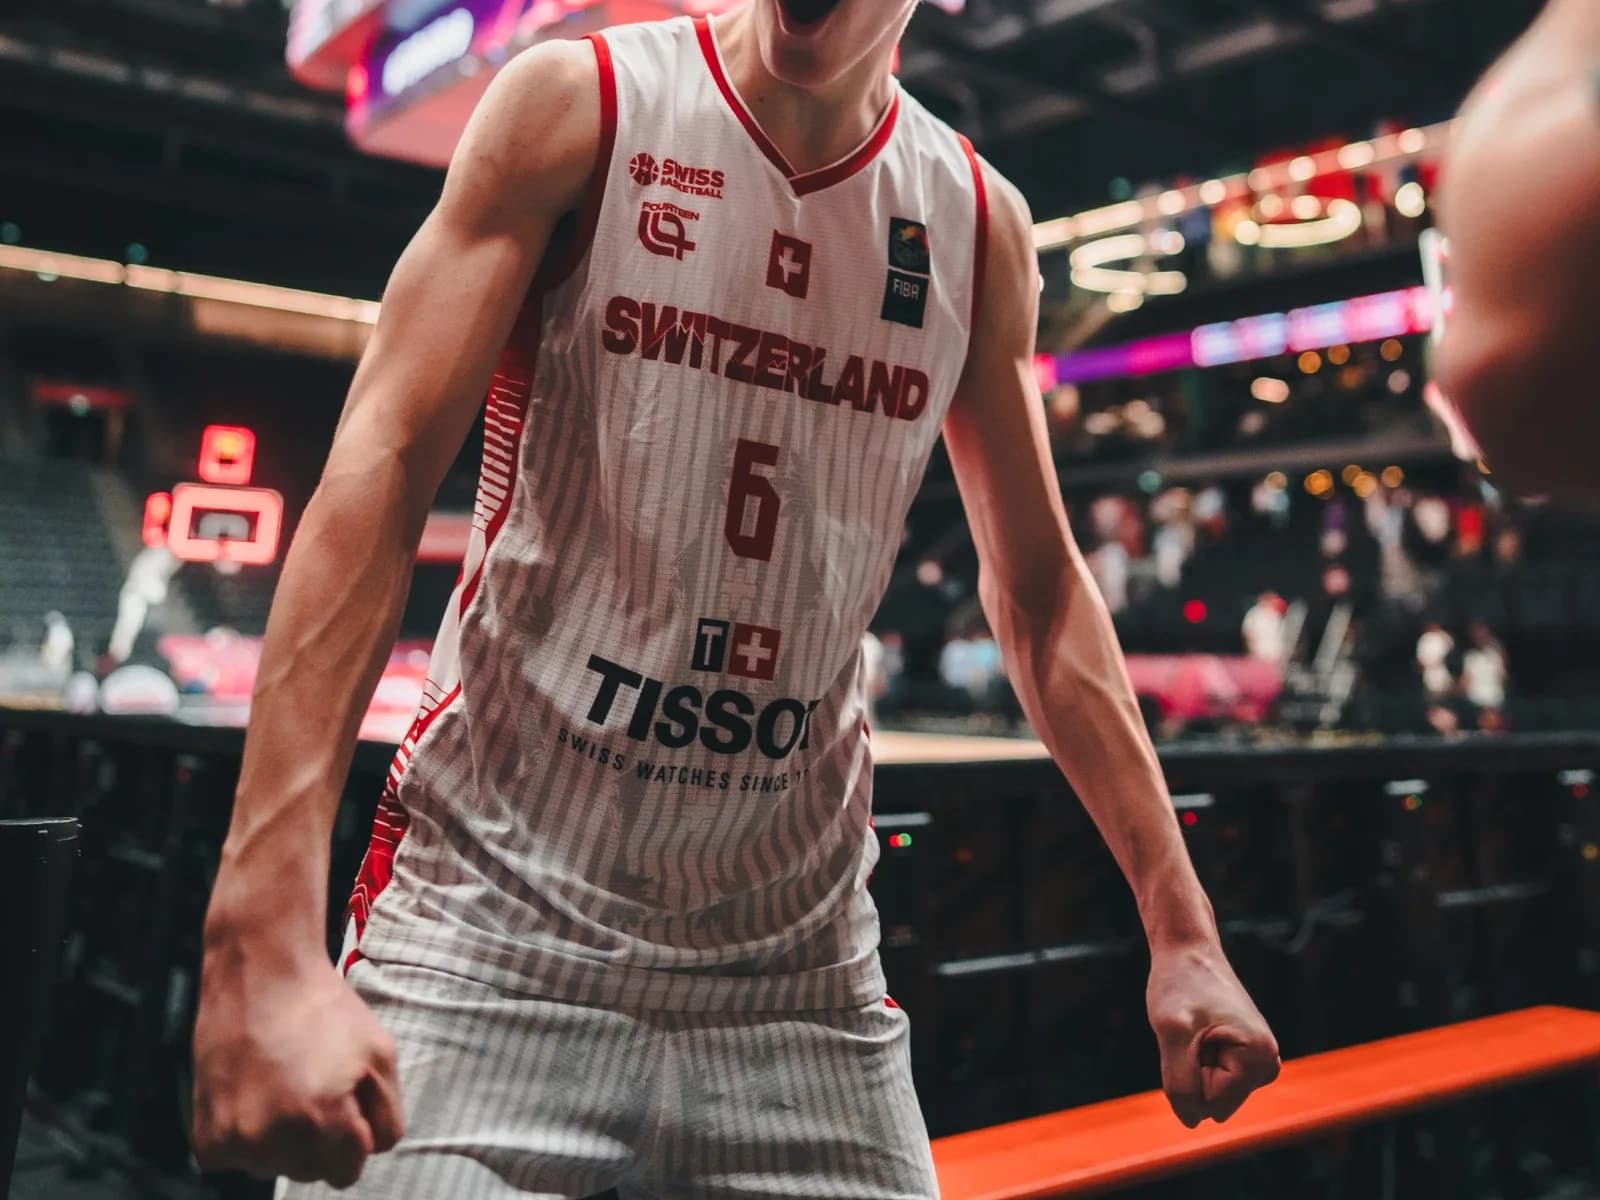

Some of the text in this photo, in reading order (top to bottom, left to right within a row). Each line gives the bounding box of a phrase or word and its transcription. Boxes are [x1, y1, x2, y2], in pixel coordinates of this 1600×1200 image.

[662, 158, 725, 188] SWISS
[641, 201, 700, 221] FOURTEEN
[893, 278, 919, 300] FIBA
[601, 295, 929, 421] SWITZERLAND
[724, 438, 781, 562] 6
[558, 727, 625, 770] SWISS
[636, 760, 731, 790] WATCHES
[740, 772, 788, 792] SINCE
